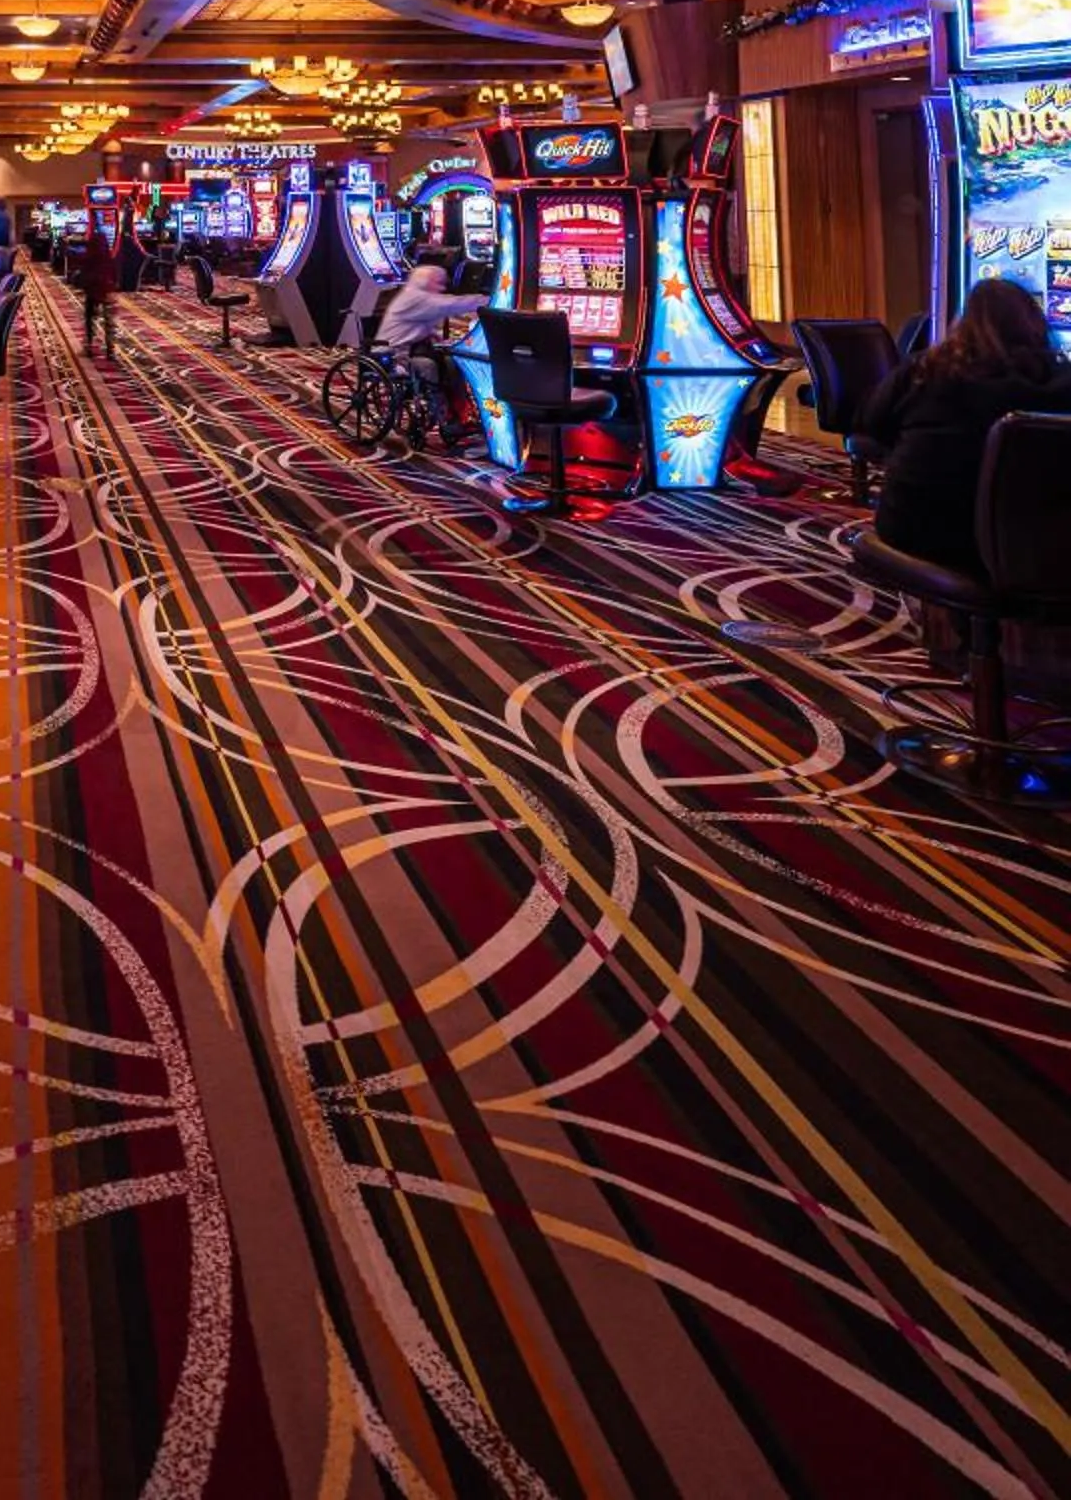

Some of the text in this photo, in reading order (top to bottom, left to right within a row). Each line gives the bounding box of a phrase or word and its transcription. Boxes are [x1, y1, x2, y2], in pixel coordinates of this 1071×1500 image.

[166, 143, 317, 159] CENTURY THEATRES
[542, 203, 620, 225] WILD RED
